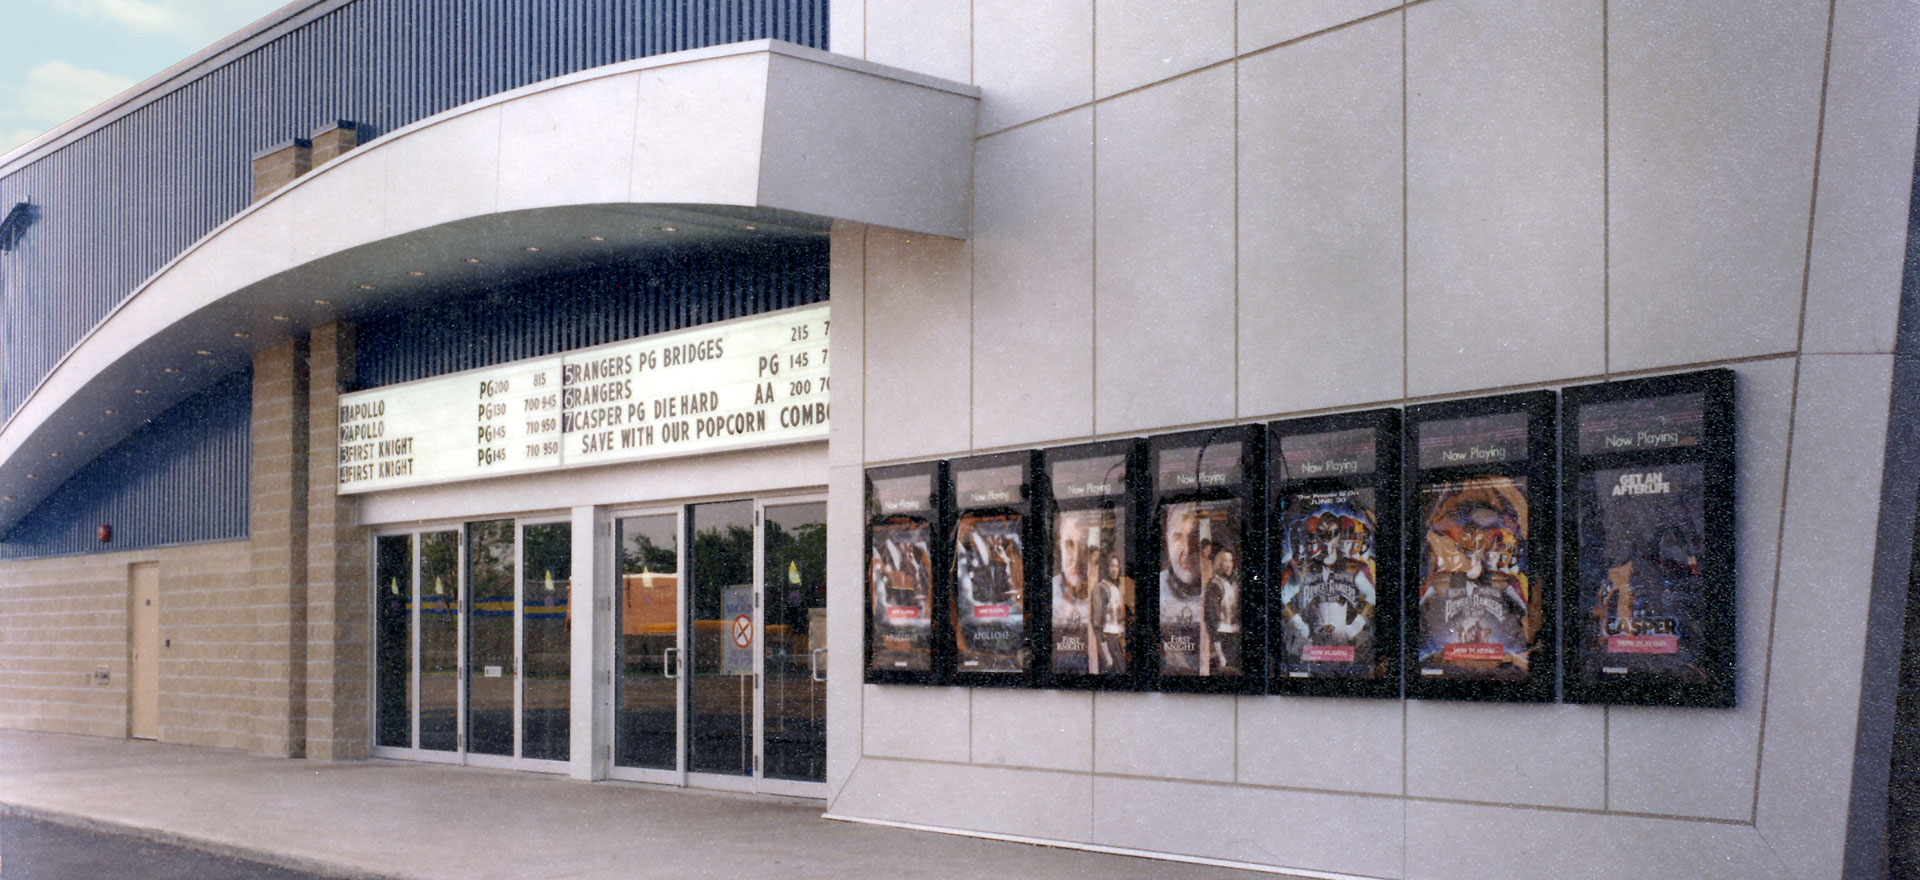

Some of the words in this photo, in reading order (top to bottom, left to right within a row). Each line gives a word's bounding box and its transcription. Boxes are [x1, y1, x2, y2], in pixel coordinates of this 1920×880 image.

[574, 355, 632, 382] RANGERS
[639, 350, 656, 372] PG
[663, 338, 724, 368] BRIDGES
[791, 325, 808, 341] 215
[574, 379, 632, 407] RANGERS
[758, 354, 779, 377] PG
[790, 352, 808, 368] 145
[349, 400, 385, 420] APOLLO
[533, 373, 547, 387] 815
[574, 405, 622, 431] CASPER
[628, 402, 645, 424] PG
[654, 397, 676, 420] DIE
[681, 390, 719, 415] HARD
[754, 382, 775, 405] AA
[790, 379, 811, 396] 200
[349, 421, 385, 441] APOLLO
[524, 397, 540, 412] 700
[541, 394, 557, 409] 945
[582, 428, 614, 454] SAVE
[621, 425, 654, 449] WITH
[661, 420, 690, 444] OUR
[696, 410, 766, 439] POPCORN
[349, 442, 375, 462] FIRST
[378, 437, 414, 458] KNIGHT
[526, 421, 539, 435] 710
[541, 418, 556, 433] 950
[1442, 449, 1467, 461] Now
[1470, 445, 1506, 462] Playing
[1605, 434, 1633, 448] Now
[1637, 431, 1679, 447] Playing
[349, 463, 374, 482] FIRST
[378, 458, 414, 479] KNIGHT
[526, 444, 540, 458] 710
[543, 441, 558, 456] 950
[1301, 461, 1323, 474] Now
[1326, 458, 1358, 474] Playing
[1068, 485, 1085, 495] Now
[1086, 482, 1112, 494] Playing
[1177, 475, 1195, 485] Now
[1199, 472, 1226, 485] Playing
[1612, 481, 1671, 496] AFTERLIFE
[1620, 473, 1643, 485] GET
[1645, 472, 1663, 483] AN
[1604, 616, 1678, 636] CASPER
